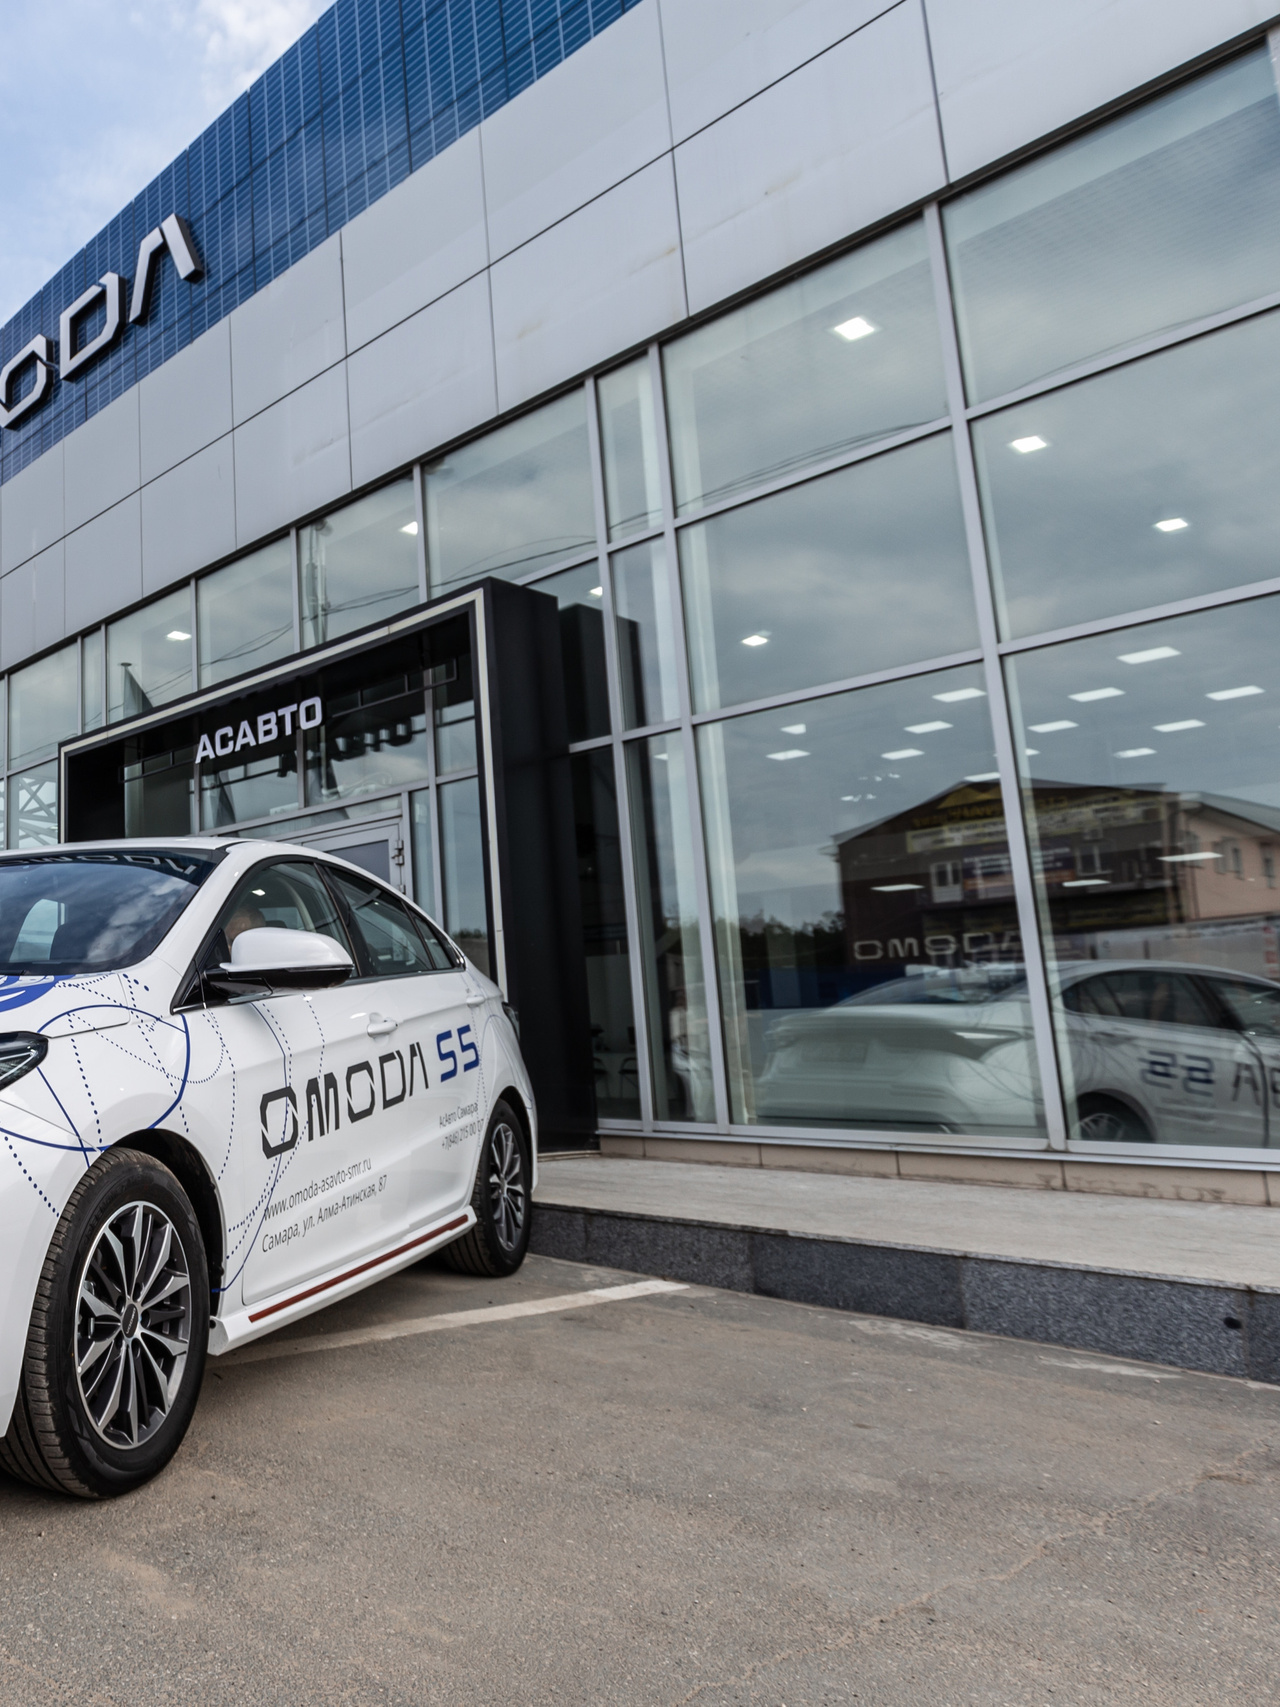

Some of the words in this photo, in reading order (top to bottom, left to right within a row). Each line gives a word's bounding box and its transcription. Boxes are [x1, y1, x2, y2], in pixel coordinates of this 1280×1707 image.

[194, 696, 324, 764] АСАВТО
[259, 1041, 429, 1159] OMODA
[262, 1223, 301, 1253] Самара,
[302, 1215, 315, 1238] ул.
[317, 1183, 377, 1225] Алма-Атинская,
[378, 1174, 387, 1192] 87
[263, 1158, 372, 1221] www.omoda-asavto-smr.ru
